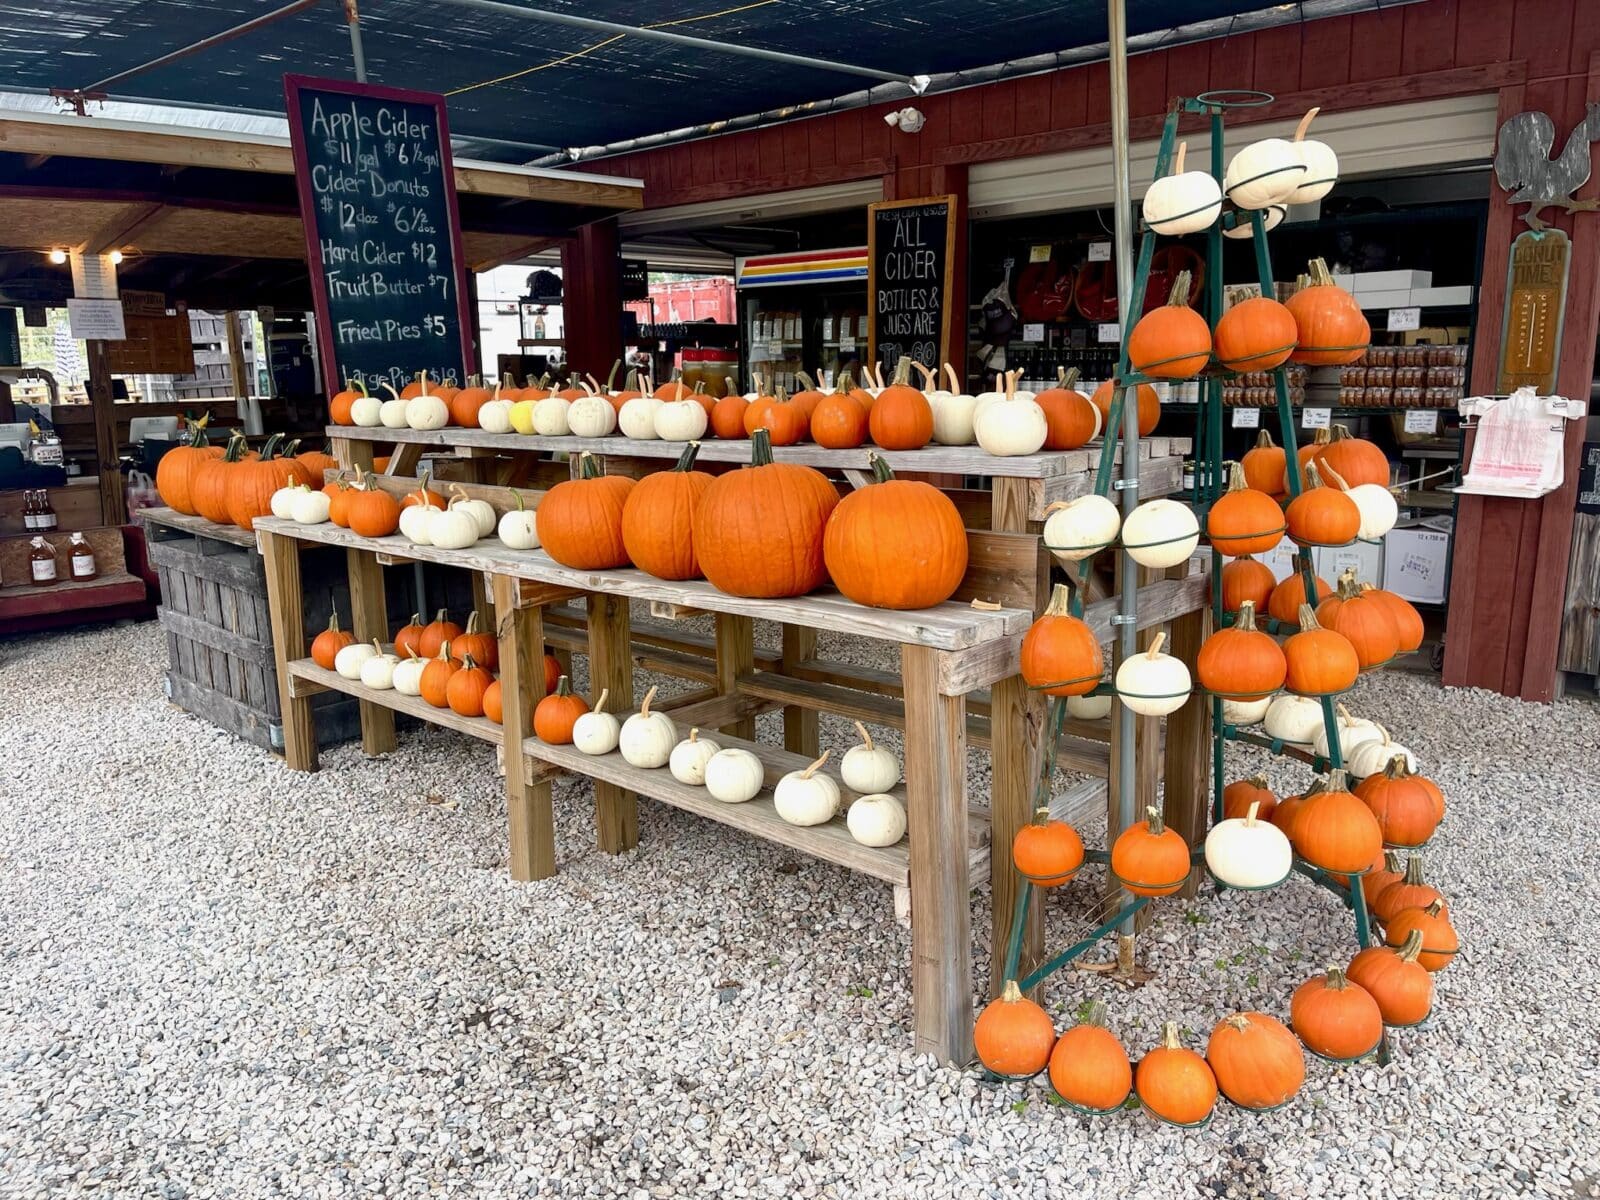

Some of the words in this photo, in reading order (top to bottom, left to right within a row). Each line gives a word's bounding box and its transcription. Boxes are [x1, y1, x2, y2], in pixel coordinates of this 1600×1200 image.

[312, 97, 375, 140] Apple
[377, 108, 430, 140] Cider
[312, 164, 365, 193] Cider
[369, 170, 430, 198] Donuts
[893, 217, 927, 248] ALL
[320, 239, 359, 265] Hard
[363, 240, 405, 265] Cider
[411, 242, 438, 266] $12
[885, 250, 936, 281] CIDER
[327, 270, 370, 298] Fruit
[370, 272, 425, 295] Butter
[428, 273, 448, 300] $7
[879, 289, 927, 314] BOTTLES
[929, 286, 940, 309] &
[338, 319, 382, 344] Fried
[383, 319, 421, 341] Pies
[423, 314, 446, 337] $5
[884, 313, 911, 336] JUGS
[913, 312, 936, 336] ARE
[341, 364, 389, 391] Large
